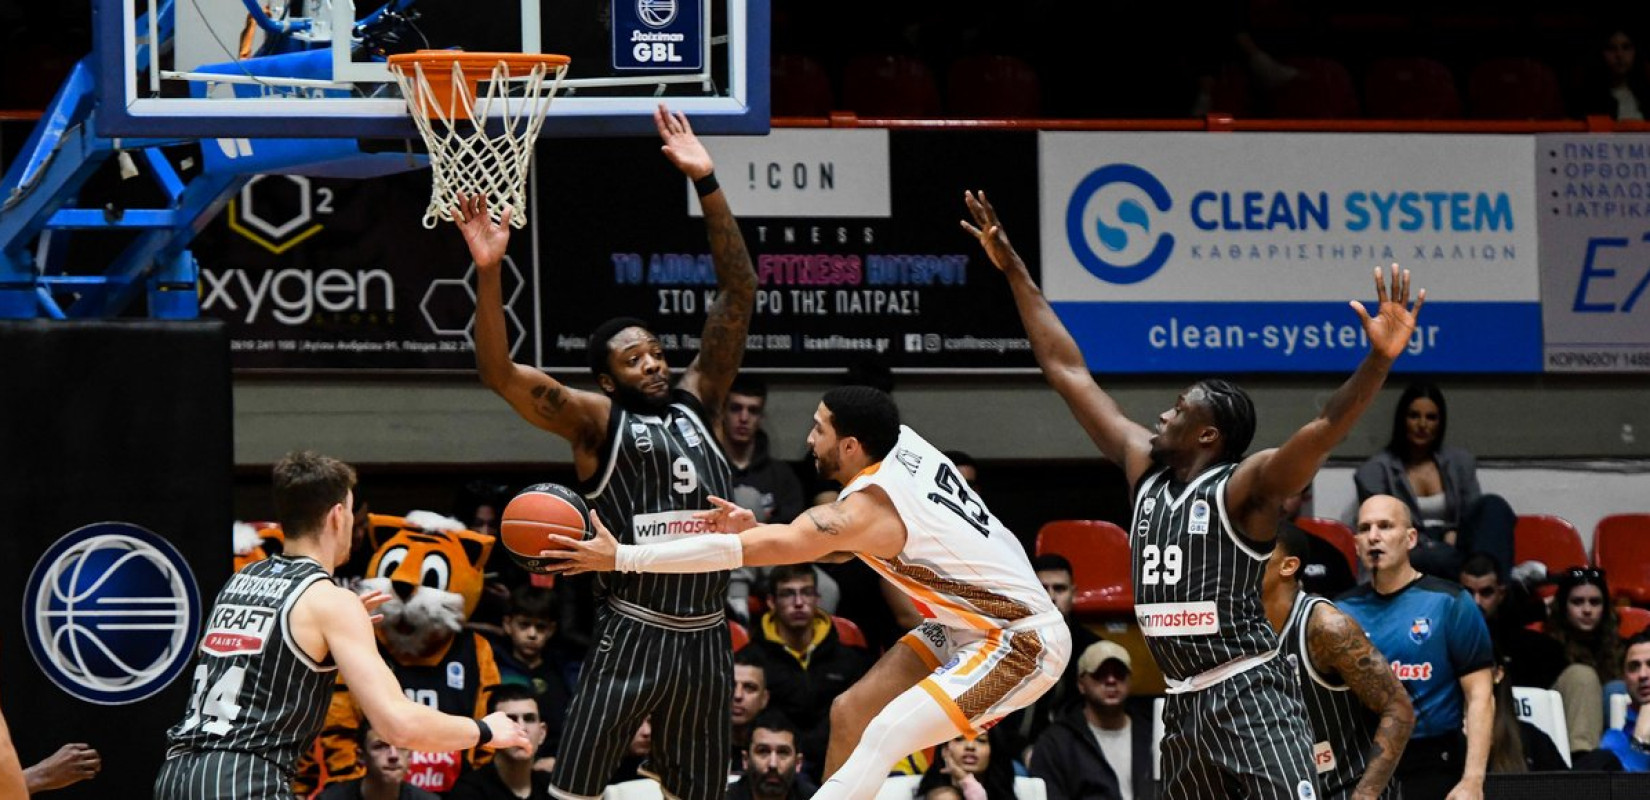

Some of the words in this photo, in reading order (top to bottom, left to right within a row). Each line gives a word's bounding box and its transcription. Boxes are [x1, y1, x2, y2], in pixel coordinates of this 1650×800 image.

[632, 42, 682, 63] GBL
[1564, 142, 1650, 158] ΠΝΕΥΜ
[316, 187, 334, 213] 2
[1190, 190, 1330, 232] CLEAN
[1344, 190, 1515, 232] SYSTEM
[757, 225, 875, 244] TNESS
[1190, 243, 1395, 260] ΚΑΘΑΡΙΣΤΗΡΙΑ
[1413, 244, 1516, 260] ΧΑΛΙΩΝ
[758, 254, 862, 285] FITNESS
[866, 254, 970, 286] HOTSPOT
[197, 268, 395, 325] xygen
[658, 289, 696, 314] ΣΤΟ
[790, 290, 828, 314] ΤΗΣ
[835, 290, 921, 314] ΠΑΤΡΑΣ!
[1149, 317, 1440, 355] clean-systegr
[672, 456, 698, 494] 9
[927, 462, 990, 539] 13
[1142, 544, 1183, 585] 29
[211, 606, 274, 633] KRAFT
[210, 636, 243, 647] PAINTS
[1391, 660, 1432, 680] last
